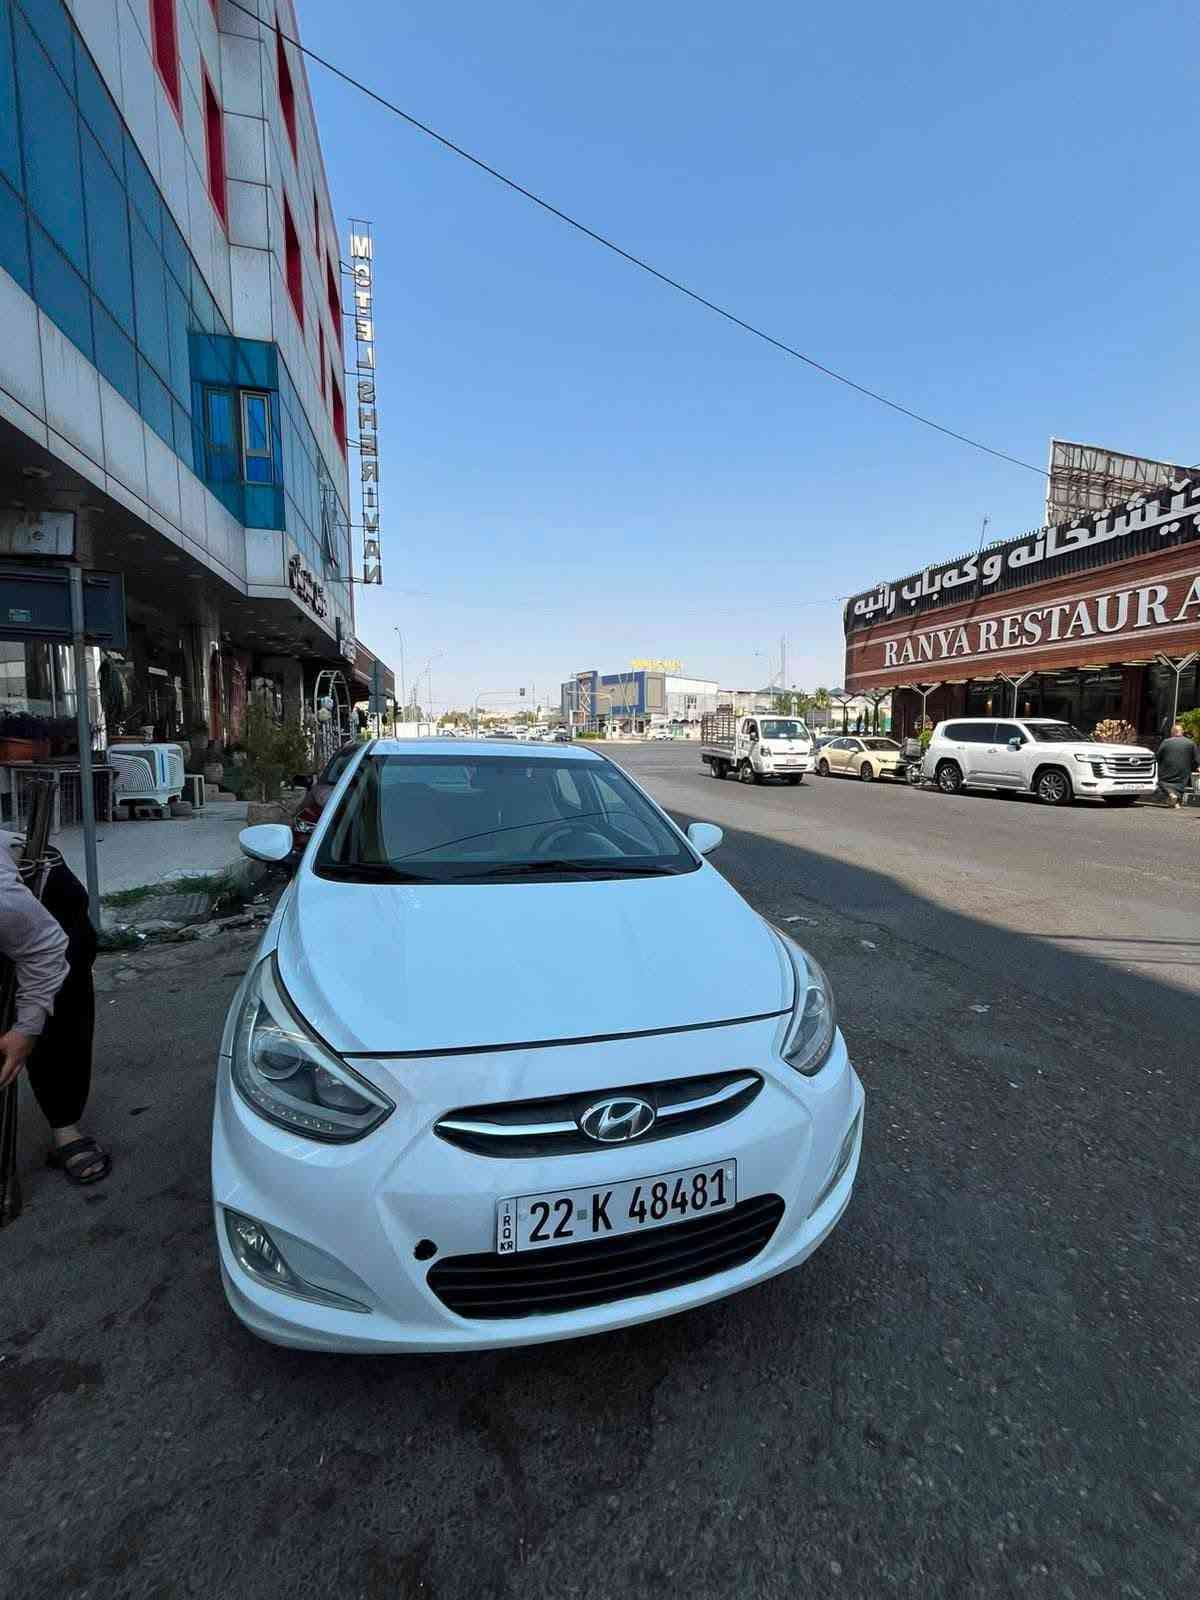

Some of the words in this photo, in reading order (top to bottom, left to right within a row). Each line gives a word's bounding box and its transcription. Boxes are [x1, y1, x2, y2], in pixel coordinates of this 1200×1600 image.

[884, 626, 971, 667] RANYA
[529, 1198, 574, 1242] 22
[592, 1191, 613, 1232] K
[628, 1168, 727, 1224] 48481
